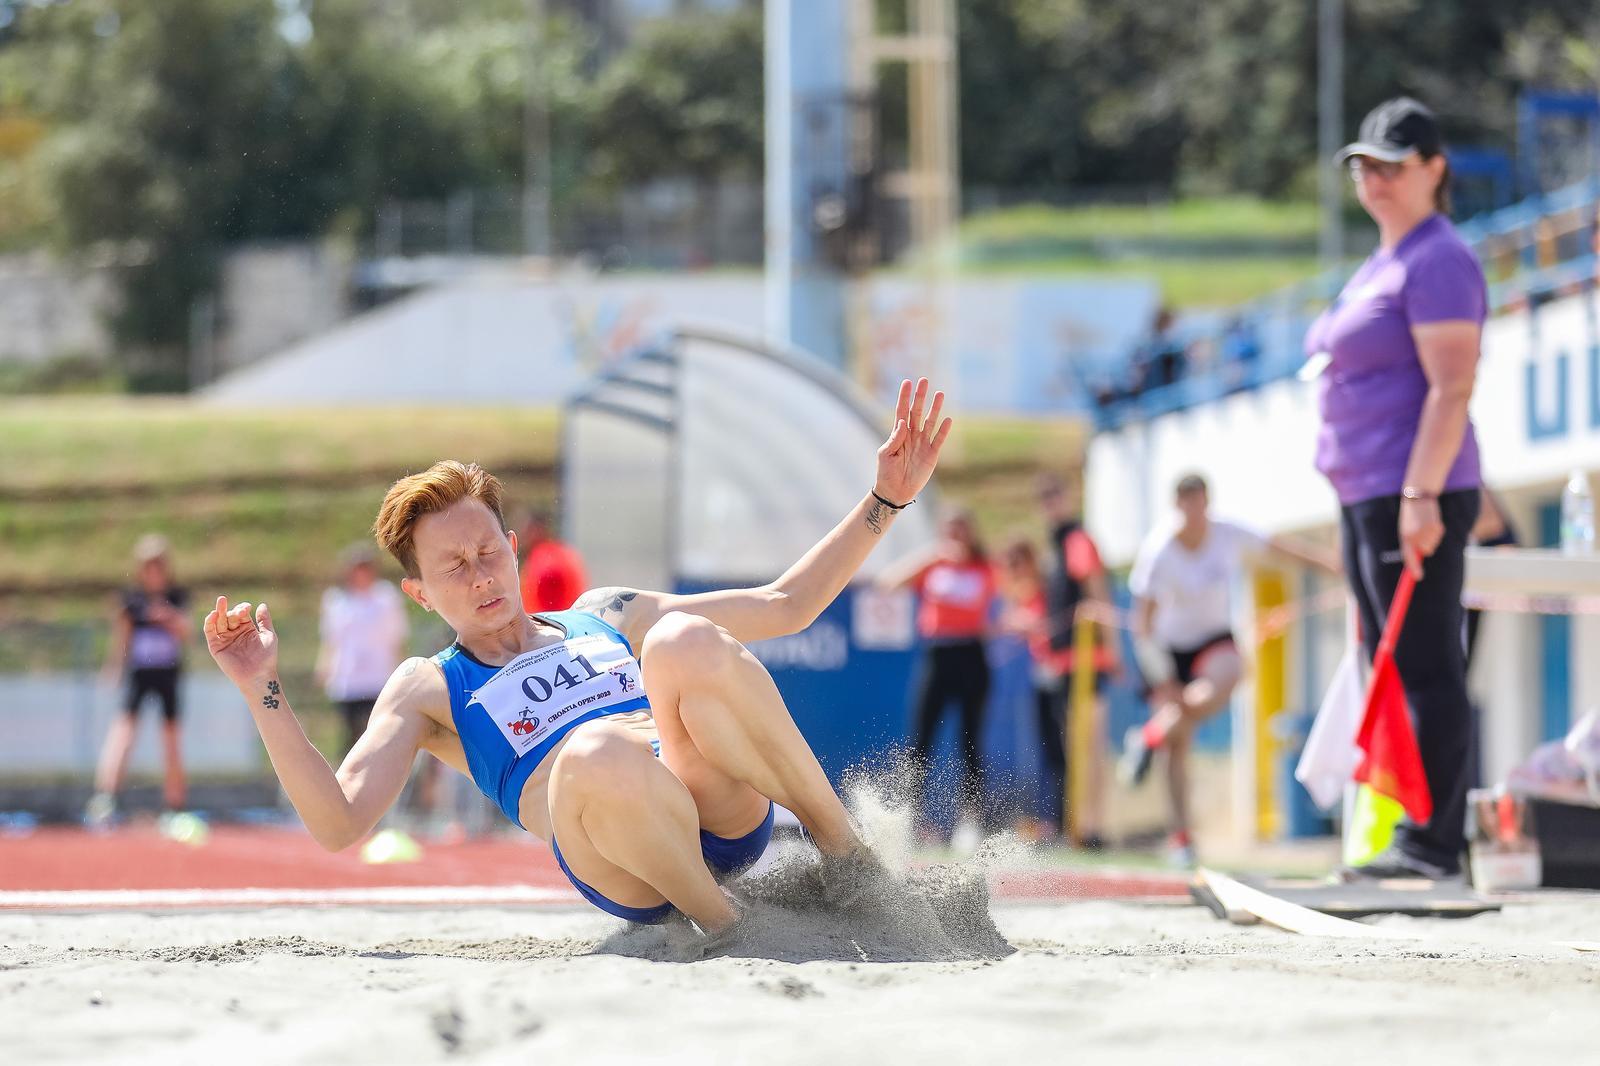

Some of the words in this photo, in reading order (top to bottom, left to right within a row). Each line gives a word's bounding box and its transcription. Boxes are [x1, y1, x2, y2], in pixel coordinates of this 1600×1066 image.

[521, 654, 605, 702] 041
[547, 704, 577, 723] CROATIA
[577, 695, 596, 707] OPEN
[596, 690, 611, 699] 2023
